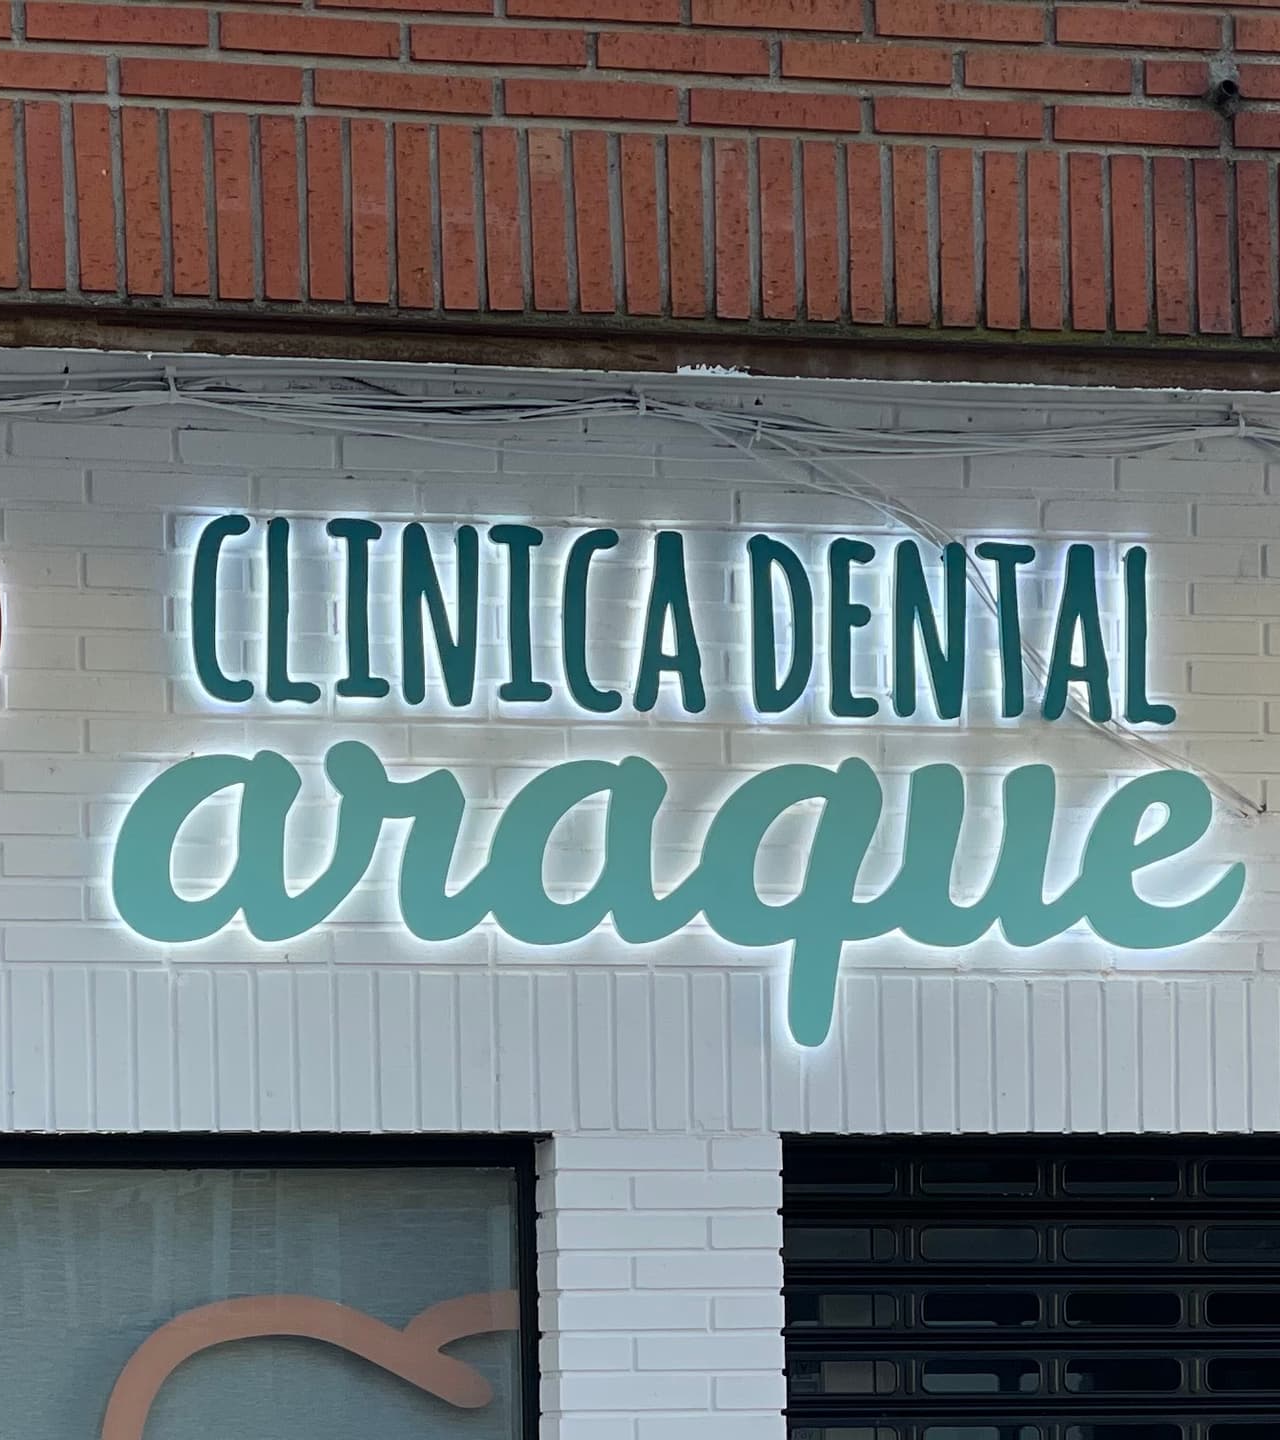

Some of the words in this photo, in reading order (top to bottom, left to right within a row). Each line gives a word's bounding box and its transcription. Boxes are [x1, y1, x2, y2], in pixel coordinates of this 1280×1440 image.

[191, 514, 706, 714] CLINICA
[748, 533, 1177, 725] DENTAL
[114, 740, 1245, 1048] araque
